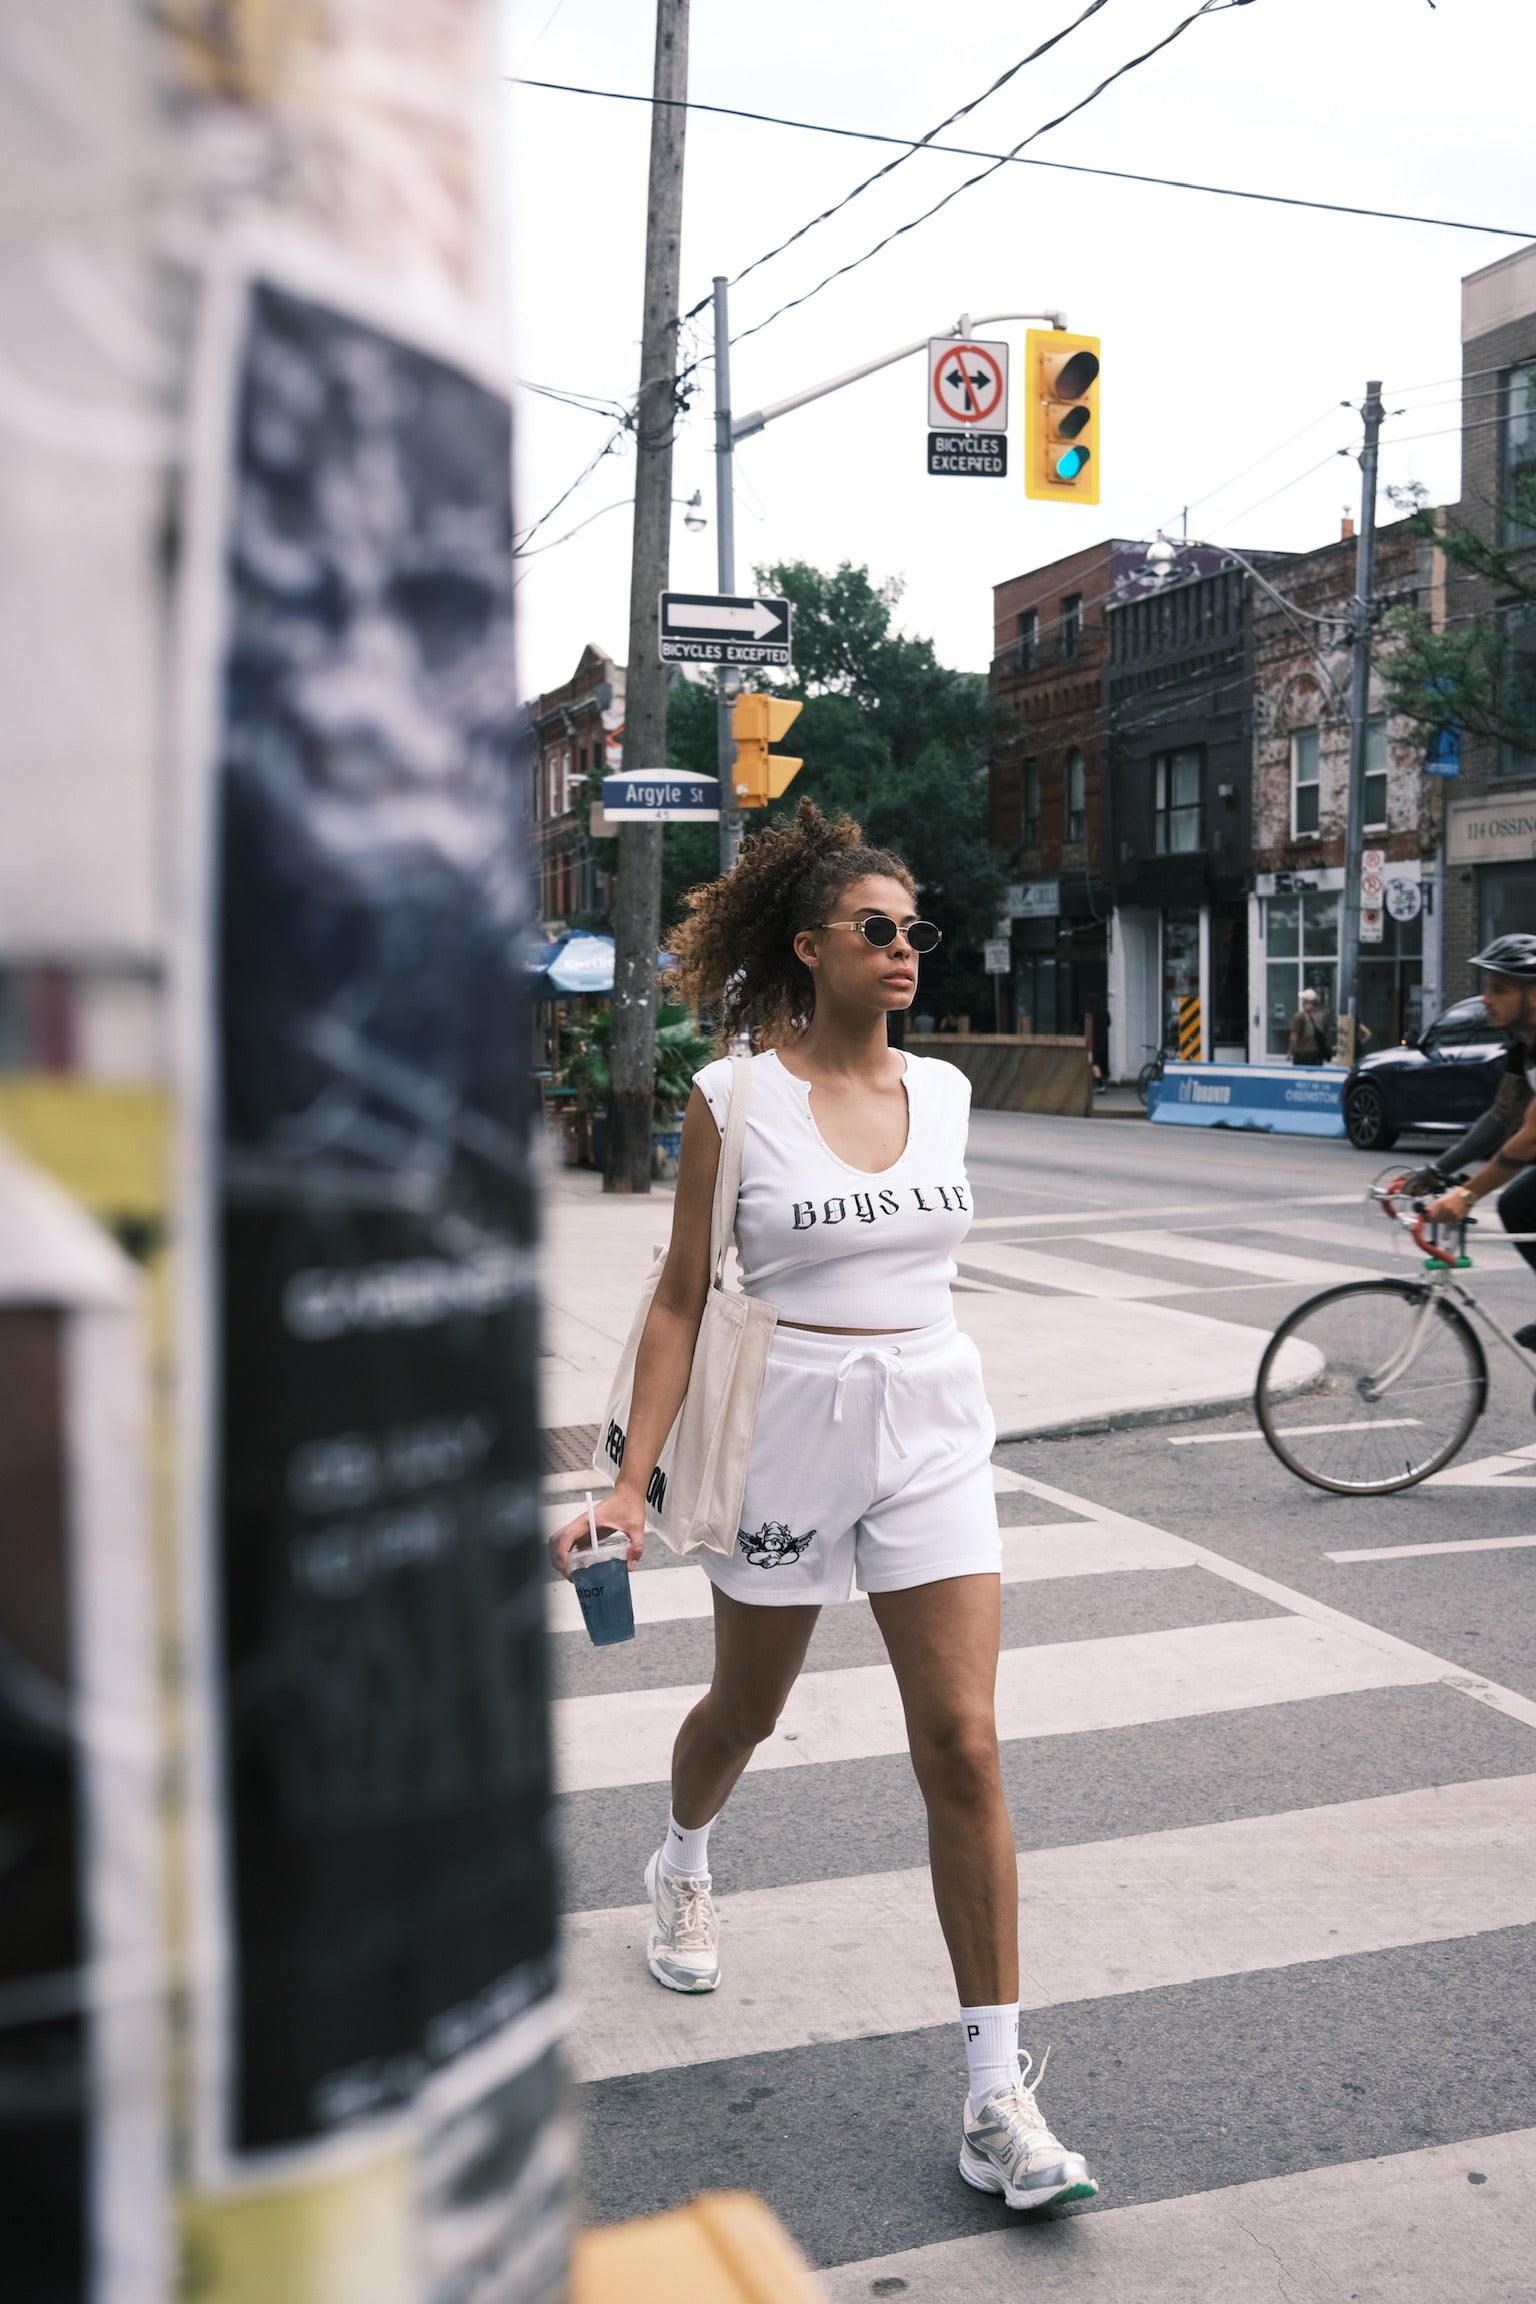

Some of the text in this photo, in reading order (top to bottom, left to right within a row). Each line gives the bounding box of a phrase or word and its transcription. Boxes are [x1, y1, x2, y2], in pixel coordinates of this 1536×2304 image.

[935, 437, 999, 454] BICYCLES
[931, 455, 1003, 472] EXCEPTED
[662, 643, 788, 663] BICYCLES EXCEPTED
[625, 783, 704, 806] Argyle St
[1488, 815, 1536, 838] OSSIN
[792, 1189, 900, 1230] BOYS
